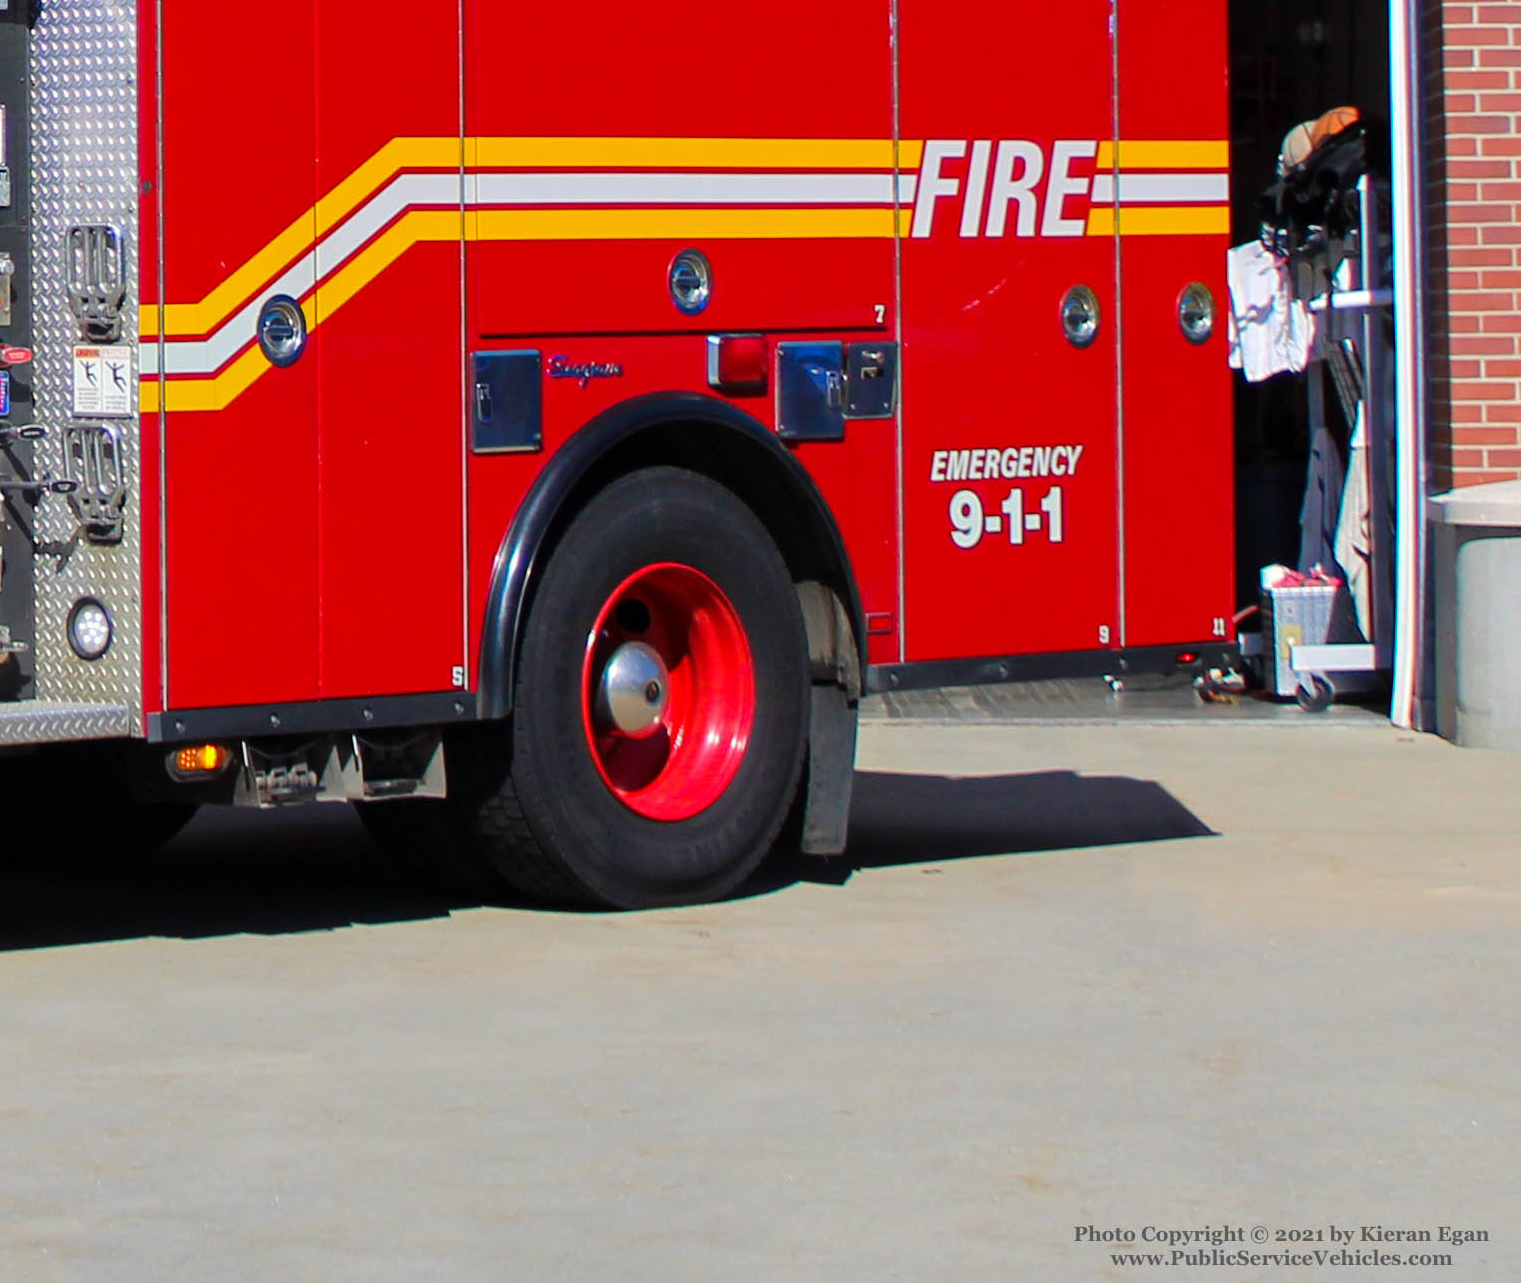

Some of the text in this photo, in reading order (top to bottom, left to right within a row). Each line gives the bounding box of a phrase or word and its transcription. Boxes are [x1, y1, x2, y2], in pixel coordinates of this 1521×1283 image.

[911, 139, 1097, 238] FIRE
[874, 304, 886, 324] 7
[930, 445, 1083, 481] EMERGENCY
[949, 486, 1062, 548] 9-1-1
